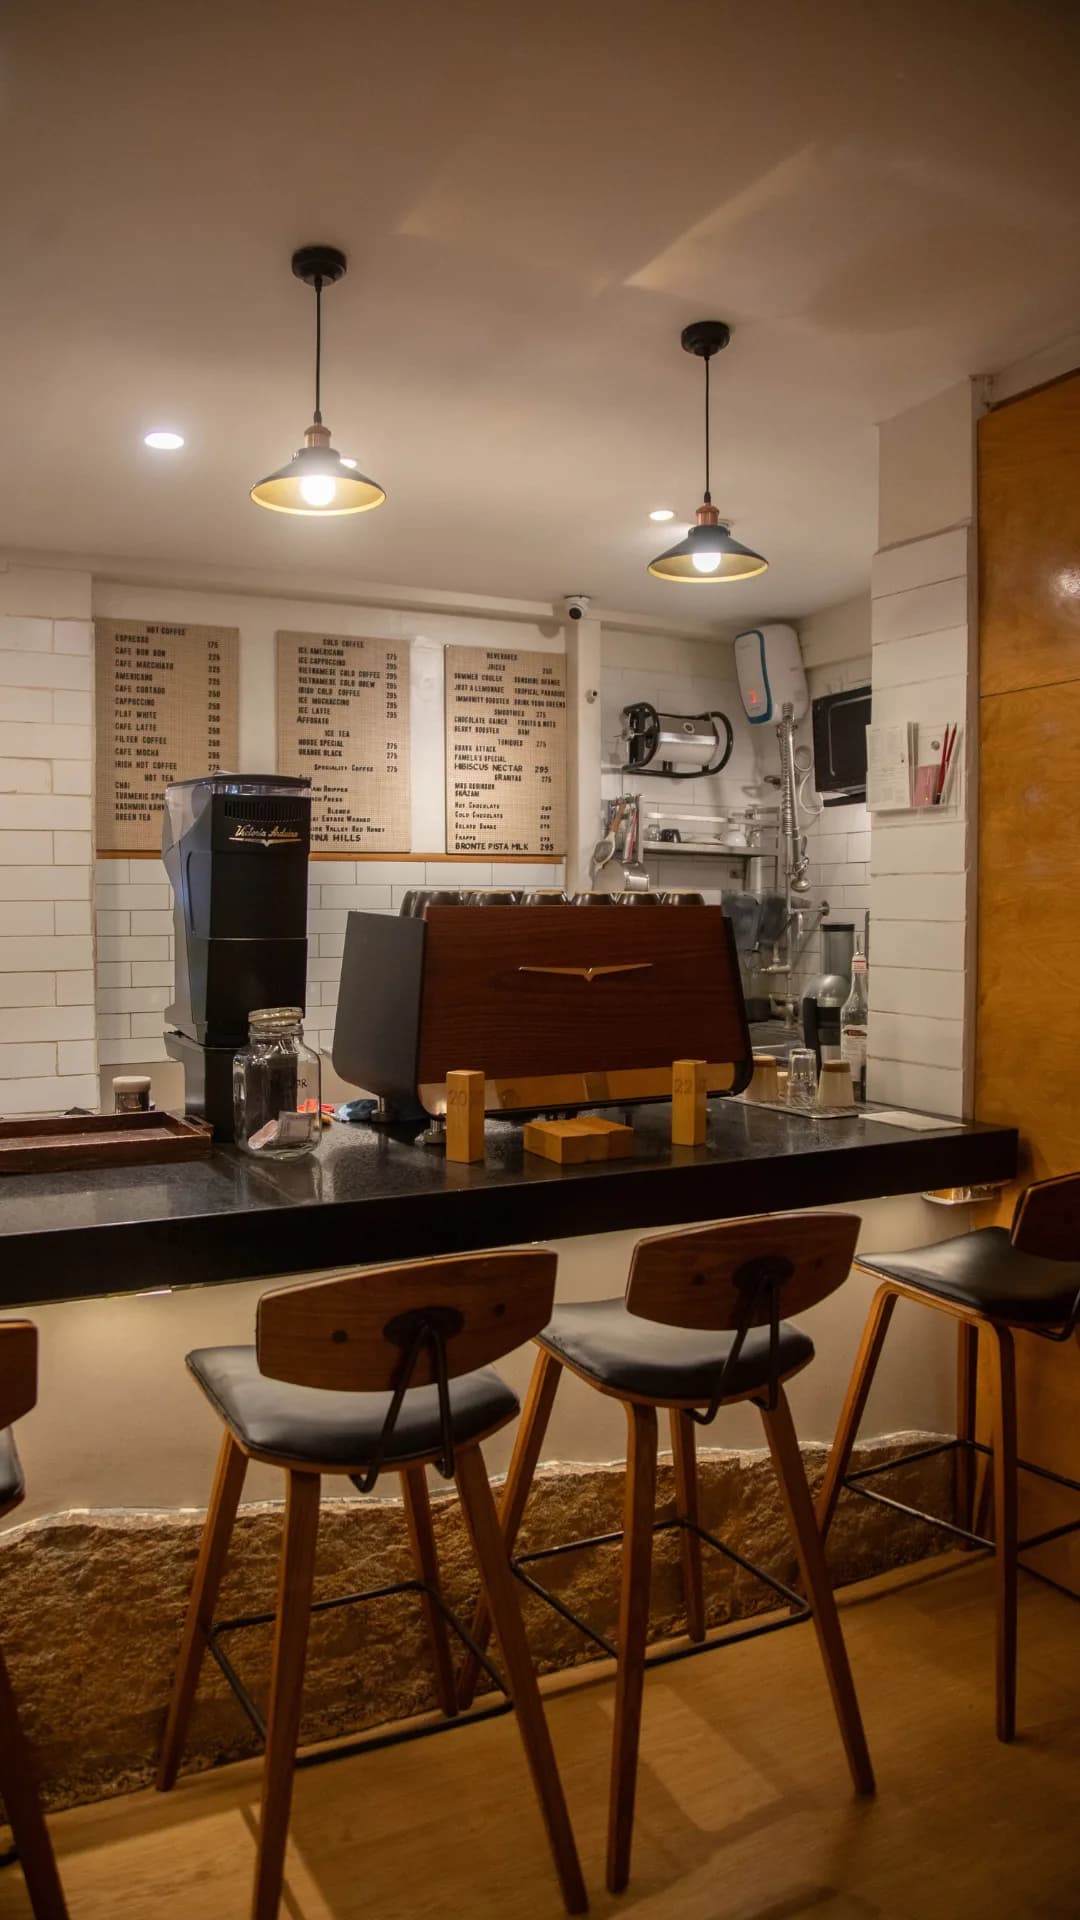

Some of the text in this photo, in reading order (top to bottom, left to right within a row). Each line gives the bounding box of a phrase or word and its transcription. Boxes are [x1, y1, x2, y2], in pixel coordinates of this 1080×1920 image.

[161, 627, 186, 636] COFFEE
[115, 634, 149, 644] ESPRESSO
[342, 640, 364, 648] COFFEE
[115, 647, 132, 655] CAFE
[115, 660, 132, 668] CAFE
[115, 672, 152, 681] AMERICANO
[115, 684, 132, 692] CAFE
[115, 697, 154, 706] CAPPUCCINO
[115, 710, 132, 718] FLAT
[136, 711, 156, 719] WHITE
[454, 716, 485, 724] CHOCOLATE
[115, 722, 132, 730] CAFE
[136, 724, 156, 732] LATTE
[115, 736, 138, 744] FILTER
[142, 736, 166, 744] COFFEE
[115, 748, 132, 756] CAFE
[116, 792, 148, 800] TURMERIC
[448, 1090, 468, 1105] 20
